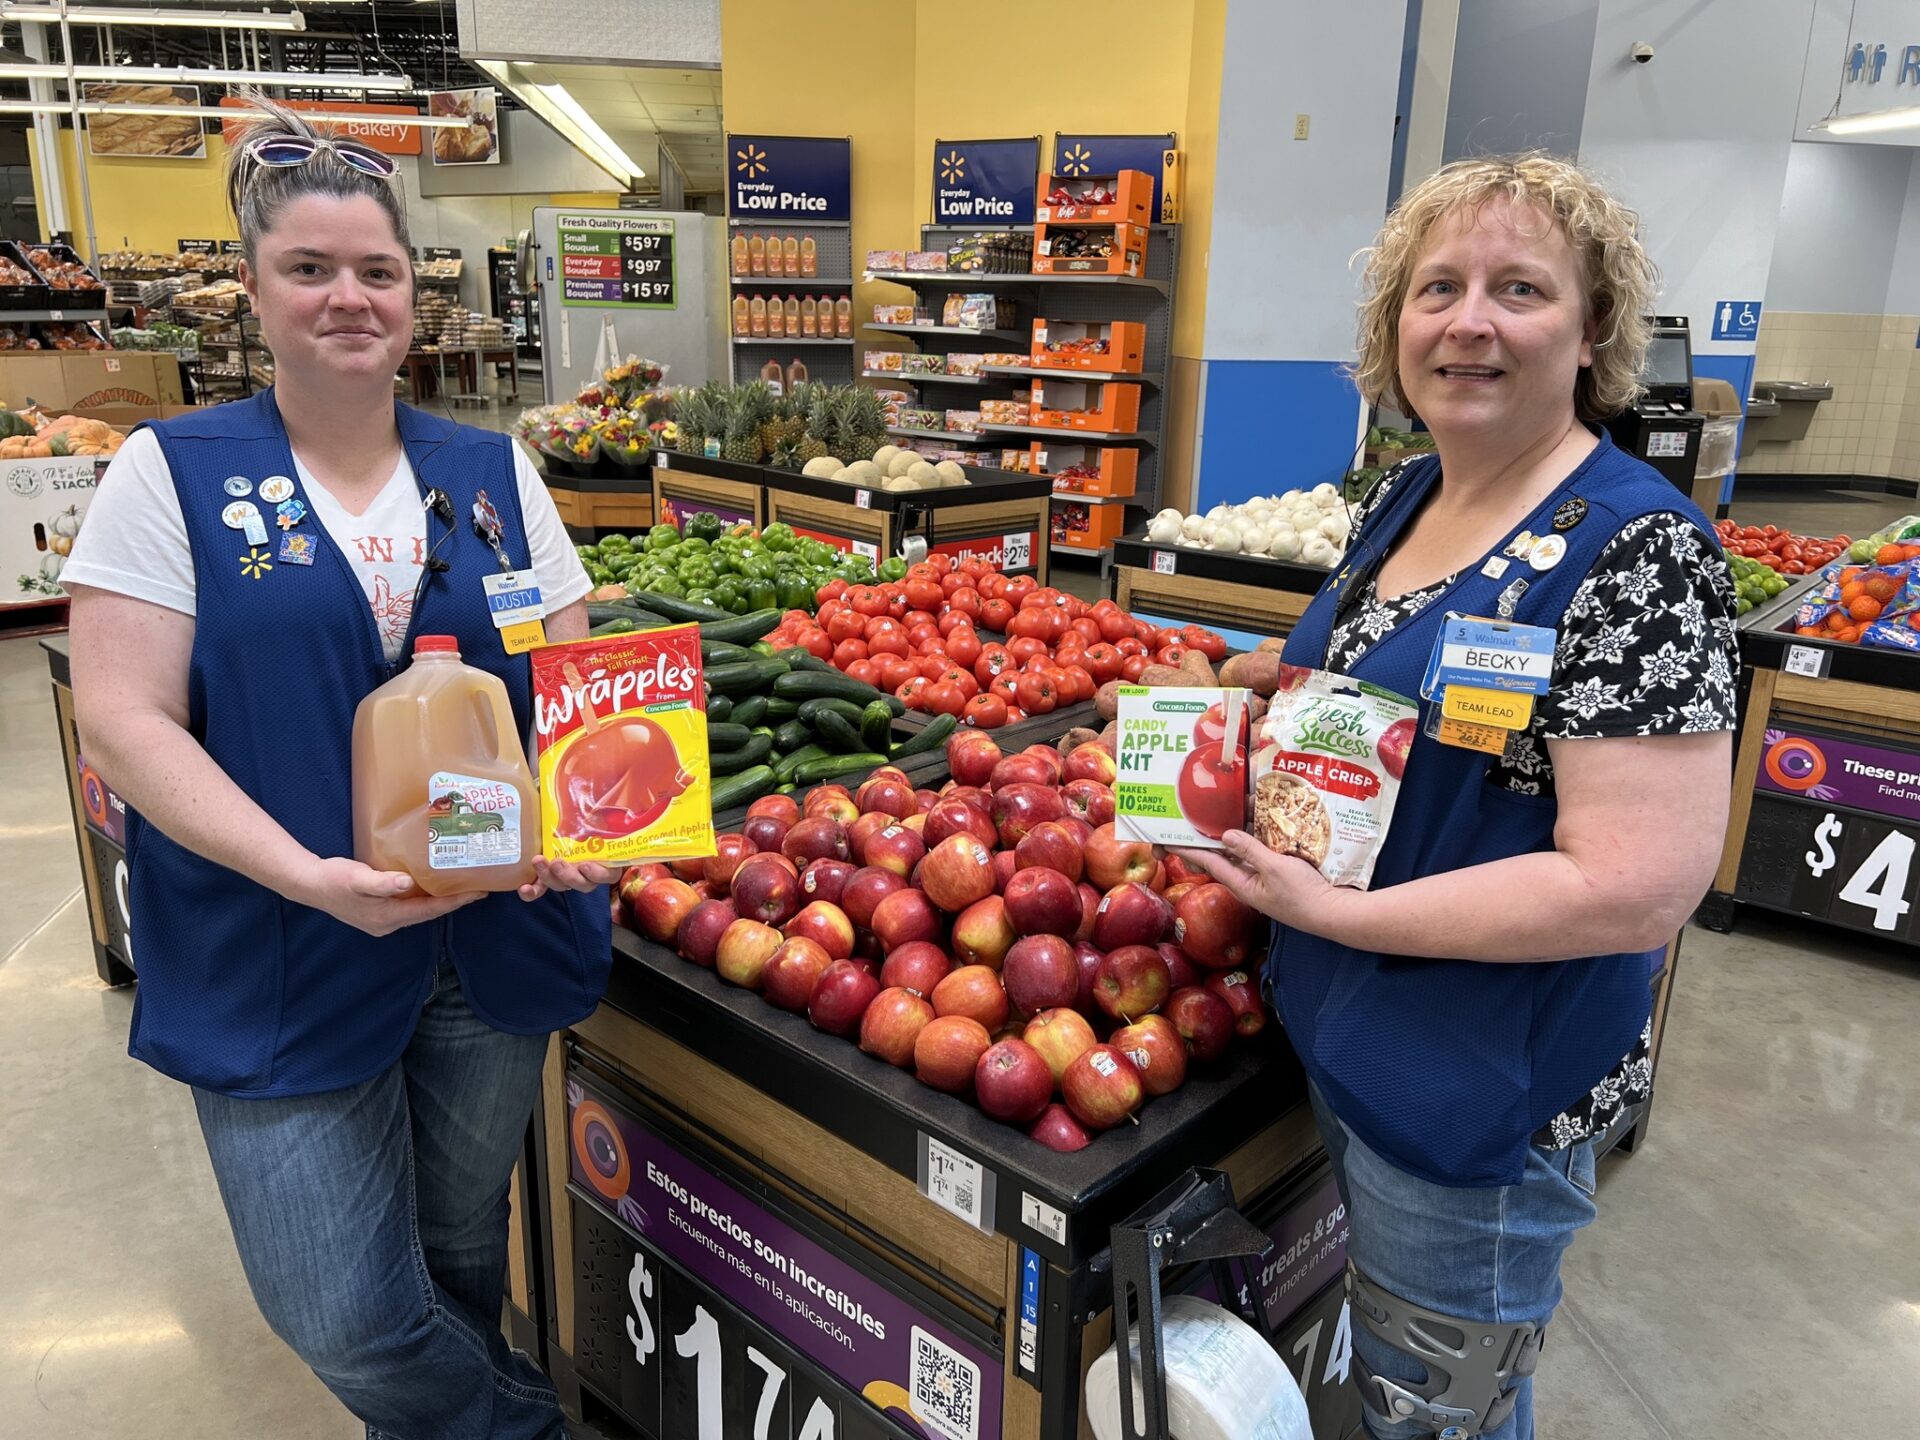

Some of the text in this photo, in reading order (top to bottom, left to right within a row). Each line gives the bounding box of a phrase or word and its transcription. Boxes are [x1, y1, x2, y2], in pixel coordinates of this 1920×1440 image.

[347, 121, 408, 142] Bakery
[737, 182, 774, 193] Everyday
[940, 189, 970, 199] Everyday
[738, 191, 827, 211] Low Price
[1163, 192, 1172, 204] A
[940, 197, 1014, 216] Low Price
[1162, 209, 1173, 220] 34
[562, 218, 658, 230] Fresh Quality Flowers
[564, 233, 587, 242] Small
[564, 243, 600, 253] Bouquet
[564, 257, 603, 268] Everyday
[565, 266, 601, 276] Bouquet
[566, 281, 604, 289] Premium
[566, 289, 603, 299] Bouquet
[52, 478, 95, 490] STACK
[943, 545, 1003, 570] ollback
[495, 590, 533, 610] DUSTY
[1459, 627, 1466, 637] 5
[1475, 633, 1517, 646] Walmart
[511, 635, 539, 647] TEAM LEAD
[590, 648, 636, 665] The Classic
[606, 655, 649, 672] Tall Treat!
[1465, 650, 1530, 671] BECKY
[656, 692, 675, 700] from
[1154, 702, 1206, 712] CONCORD FOODS
[1456, 700, 1514, 718] TEAM LEAD
[1293, 697, 1370, 737] Fresh
[1124, 719, 1168, 732] CANDY
[1122, 733, 1188, 752] APPLE
[1293, 719, 1373, 759] Success
[1120, 753, 1153, 771] KIT
[1843, 759, 1895, 781] These
[1278, 758, 1373, 788] APPLE CRISP
[464, 784, 504, 803] APPLE
[1119, 785, 1147, 794] MAKES
[1878, 784, 1905, 798] Find
[474, 796, 516, 813] CIDER
[1119, 795, 1136, 811] 10
[1137, 795, 1163, 804] CANDY
[1137, 804, 1167, 813] APPLES
[554, 844, 586, 858] Makes
[607, 838, 634, 851] Fresh
[636, 827, 677, 845] Caramel
[679, 822, 711, 836] Apples
[1035, 1205, 1062, 1223] 1 AP
[647, 1160, 886, 1340] Estos precios son increíbles
[1262, 1232, 1311, 1287] treats
[1313, 1217, 1325, 1242] &
[1027, 1260, 1036, 1272] A
[1279, 1263, 1308, 1296] more
[1309, 1255, 1319, 1270] in
[1321, 1241, 1337, 1260] the
[668, 1207, 856, 1352] Encuentra más en la aplicación.
[1028, 1282, 1033, 1292] 1
[1025, 1304, 1036, 1318] 15
[1020, 1340, 1034, 1360] 15
[923, 1408, 963, 1439] Compra ahora
